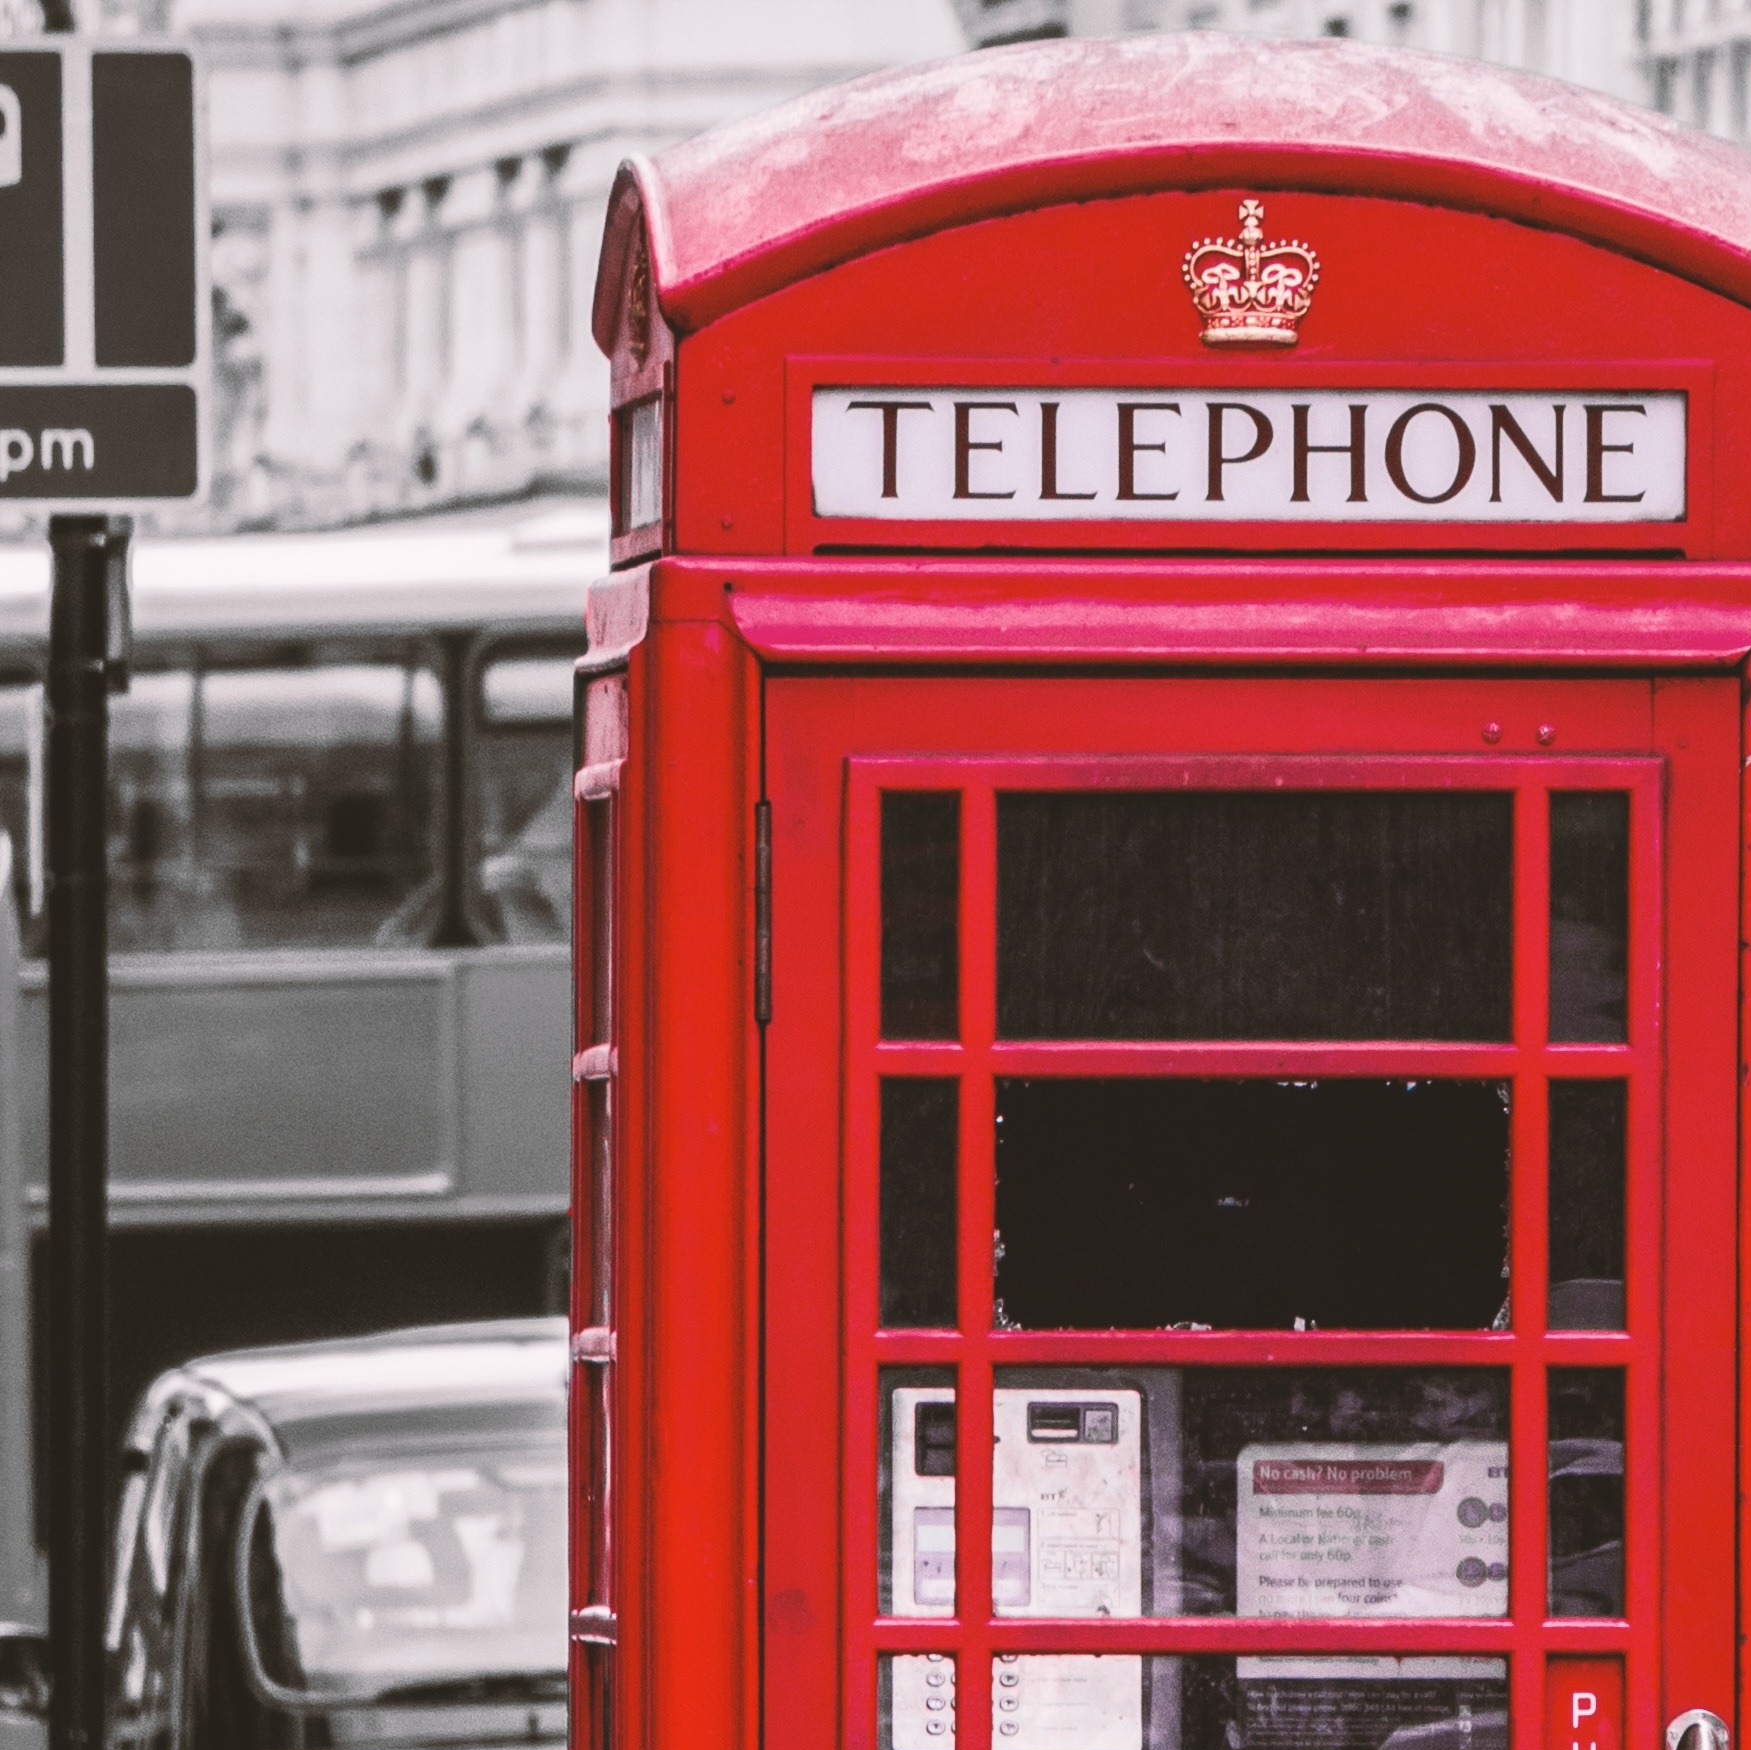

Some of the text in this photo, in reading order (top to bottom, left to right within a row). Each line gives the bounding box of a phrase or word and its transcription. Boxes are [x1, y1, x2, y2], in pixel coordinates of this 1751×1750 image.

[846, 400, 1648, 504] TELEPHONE
[1259, 1464, 1412, 1483] No cash? No problem
[1314, 1577, 1366, 1589] prepared
